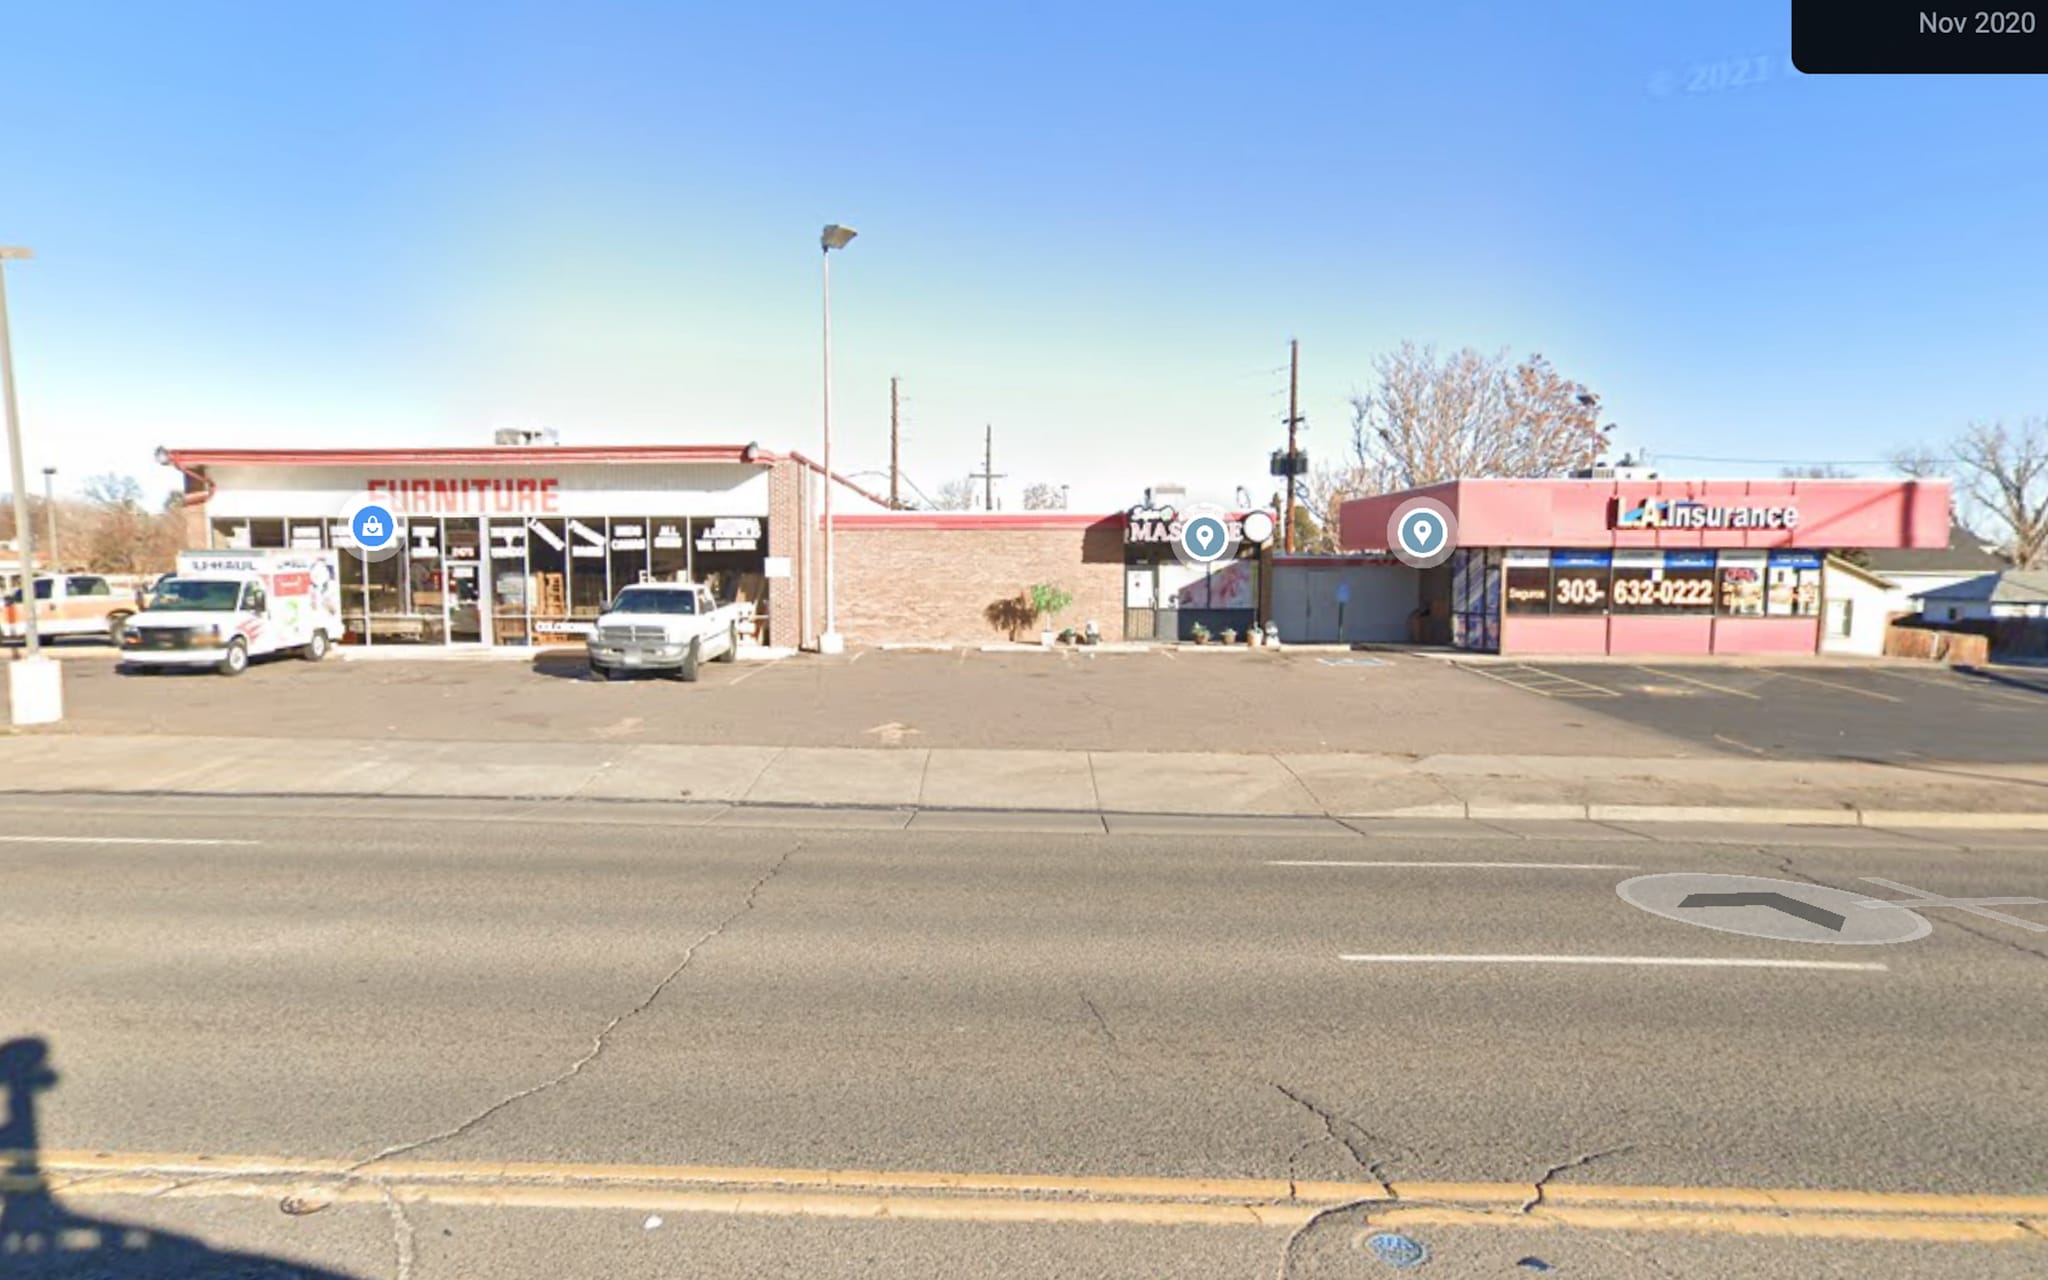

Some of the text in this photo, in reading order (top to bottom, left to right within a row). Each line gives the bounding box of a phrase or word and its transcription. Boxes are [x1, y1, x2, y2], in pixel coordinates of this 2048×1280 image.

[367, 479, 559, 513] FURNITURE
[1130, 521, 1244, 542] MASE
[1509, 587, 1547, 601] Seguros
[1613, 578, 1713, 605] 632-0222
